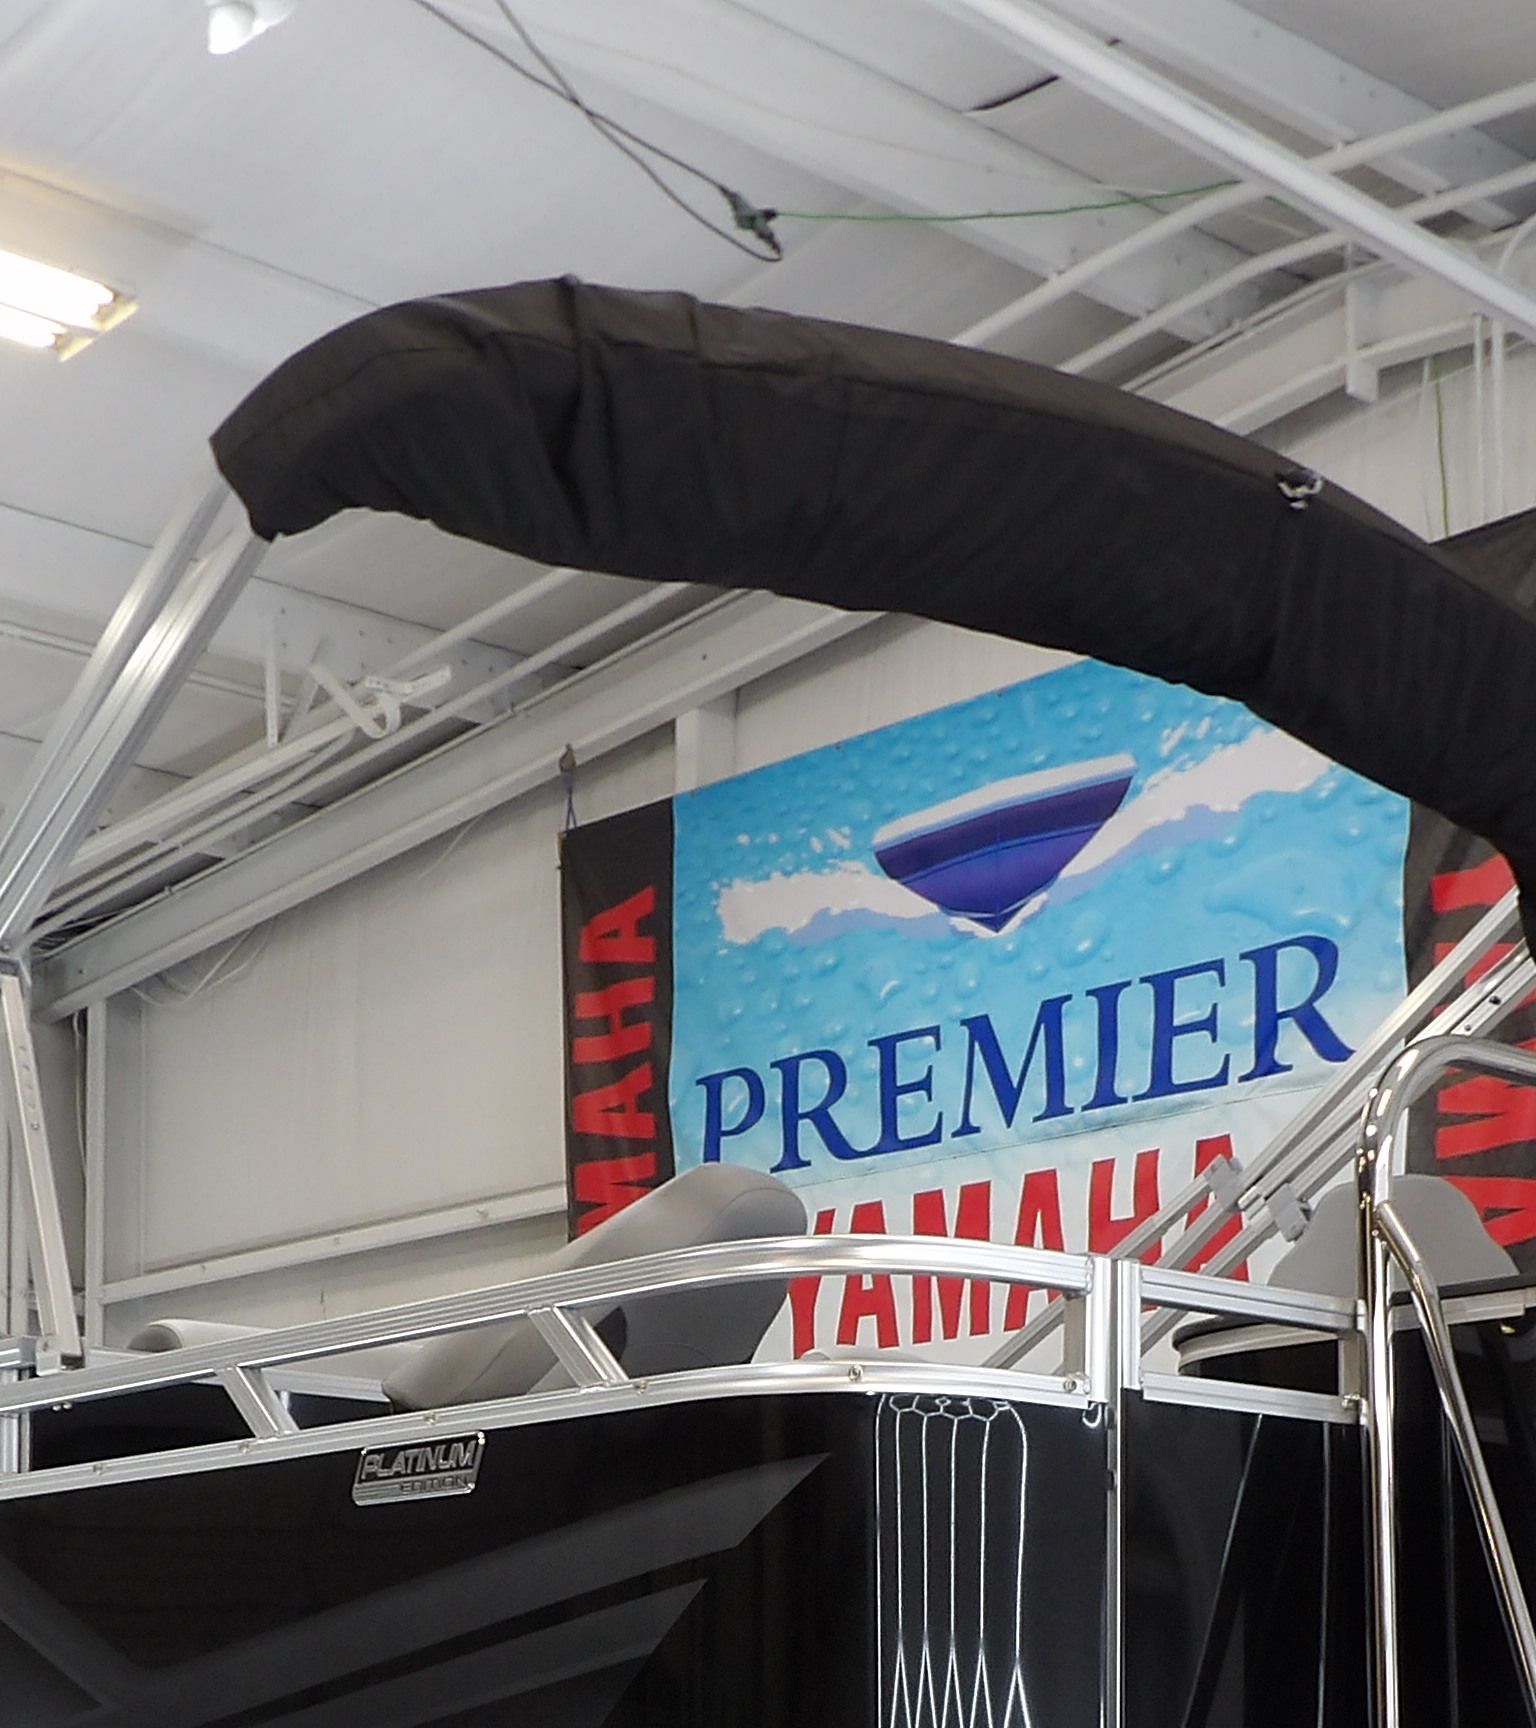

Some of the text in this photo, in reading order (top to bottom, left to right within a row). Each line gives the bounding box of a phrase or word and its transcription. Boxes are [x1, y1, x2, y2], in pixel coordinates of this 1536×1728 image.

[572, 884, 658, 1238] MAHA
[695, 934, 1358, 1173] PREMIER
[787, 1133, 1250, 1360] YAMAHA
[362, 1440, 477, 1480] PLATINUM
